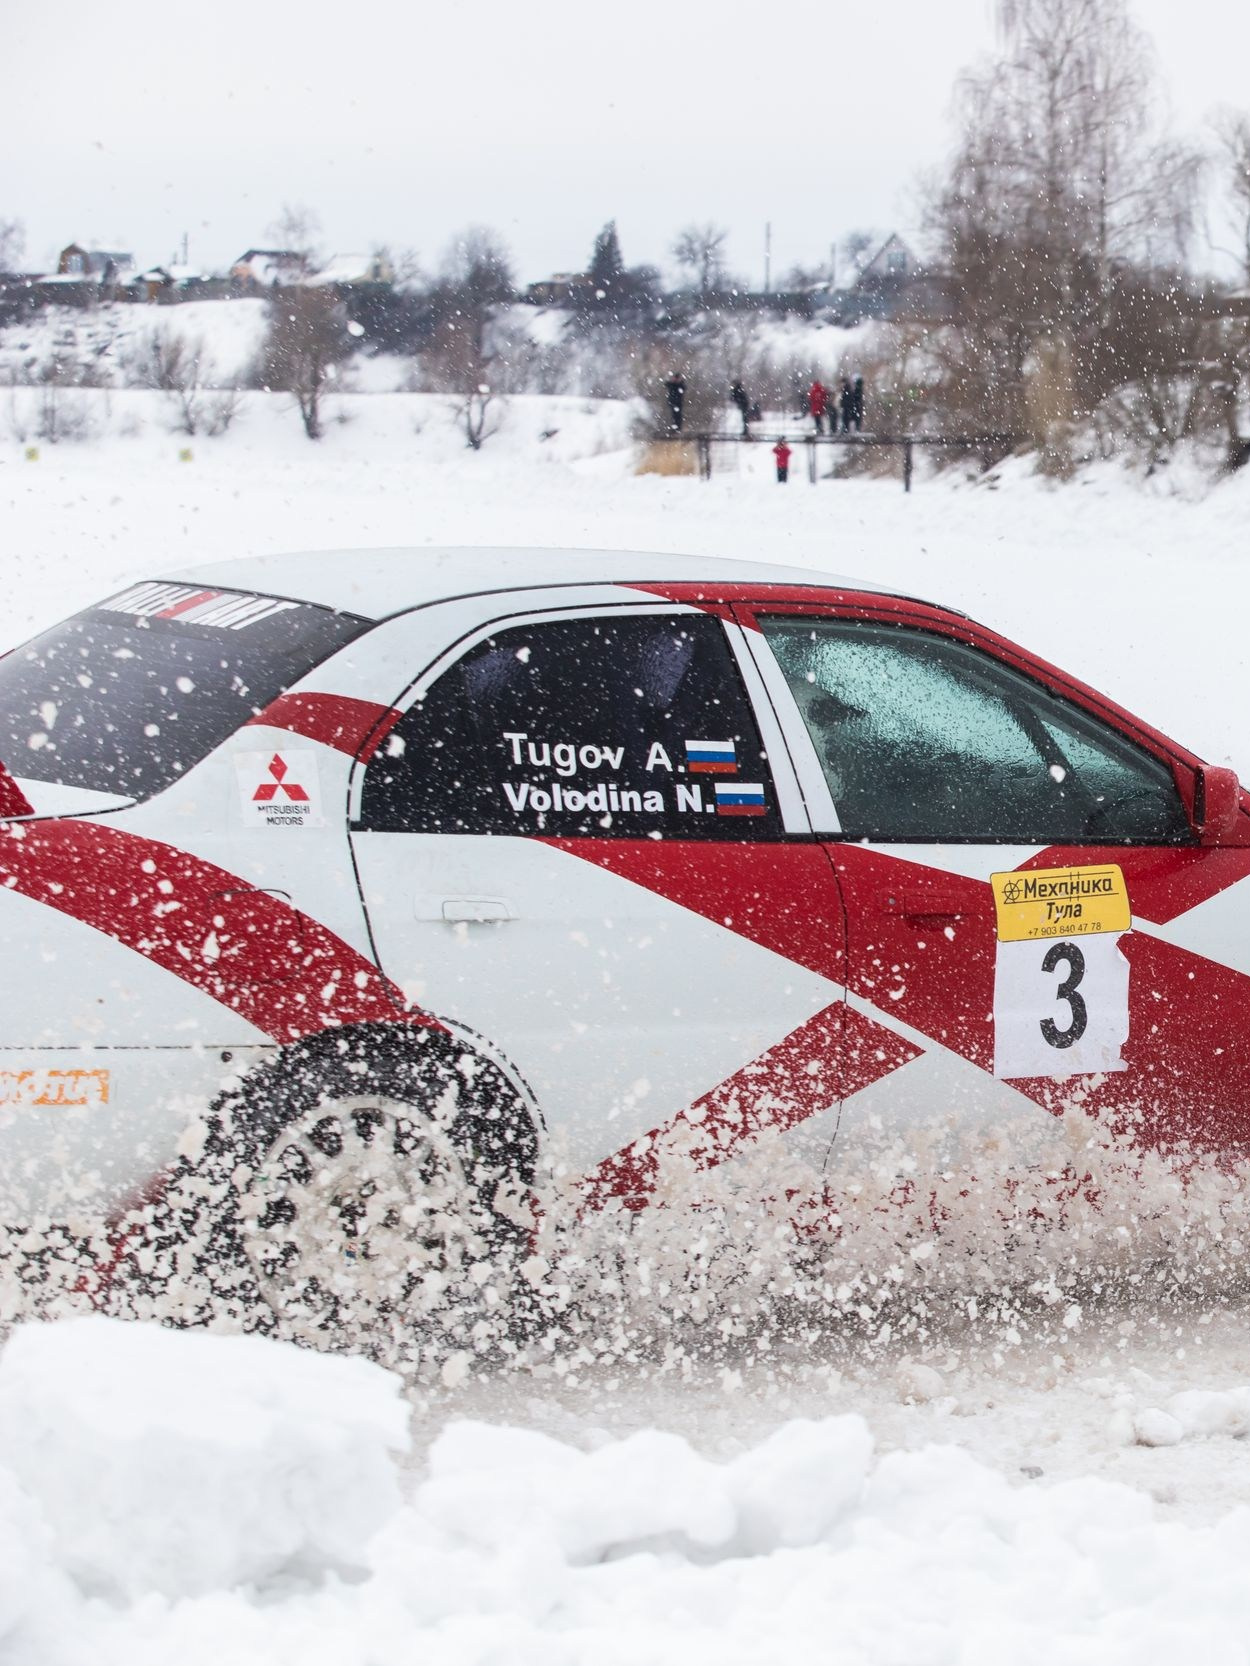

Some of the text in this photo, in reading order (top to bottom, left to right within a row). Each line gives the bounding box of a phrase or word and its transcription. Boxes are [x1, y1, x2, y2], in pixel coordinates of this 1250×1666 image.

[503, 732, 686, 777] Tugov A.
[502, 782, 715, 813] Volodina N.
[258, 805, 310, 814] MITSUBISHI
[267, 817, 303, 826] MOTORS
[1024, 877, 1112, 899] Механика
[1047, 901, 1083, 924] Тула
[1028, 927, 1039, 936] +7
[1041, 926, 1058, 936] 903
[1077, 922, 1089, 932] 47
[1091, 921, 1102, 931] 78
[1039, 941, 1088, 1049] 3
